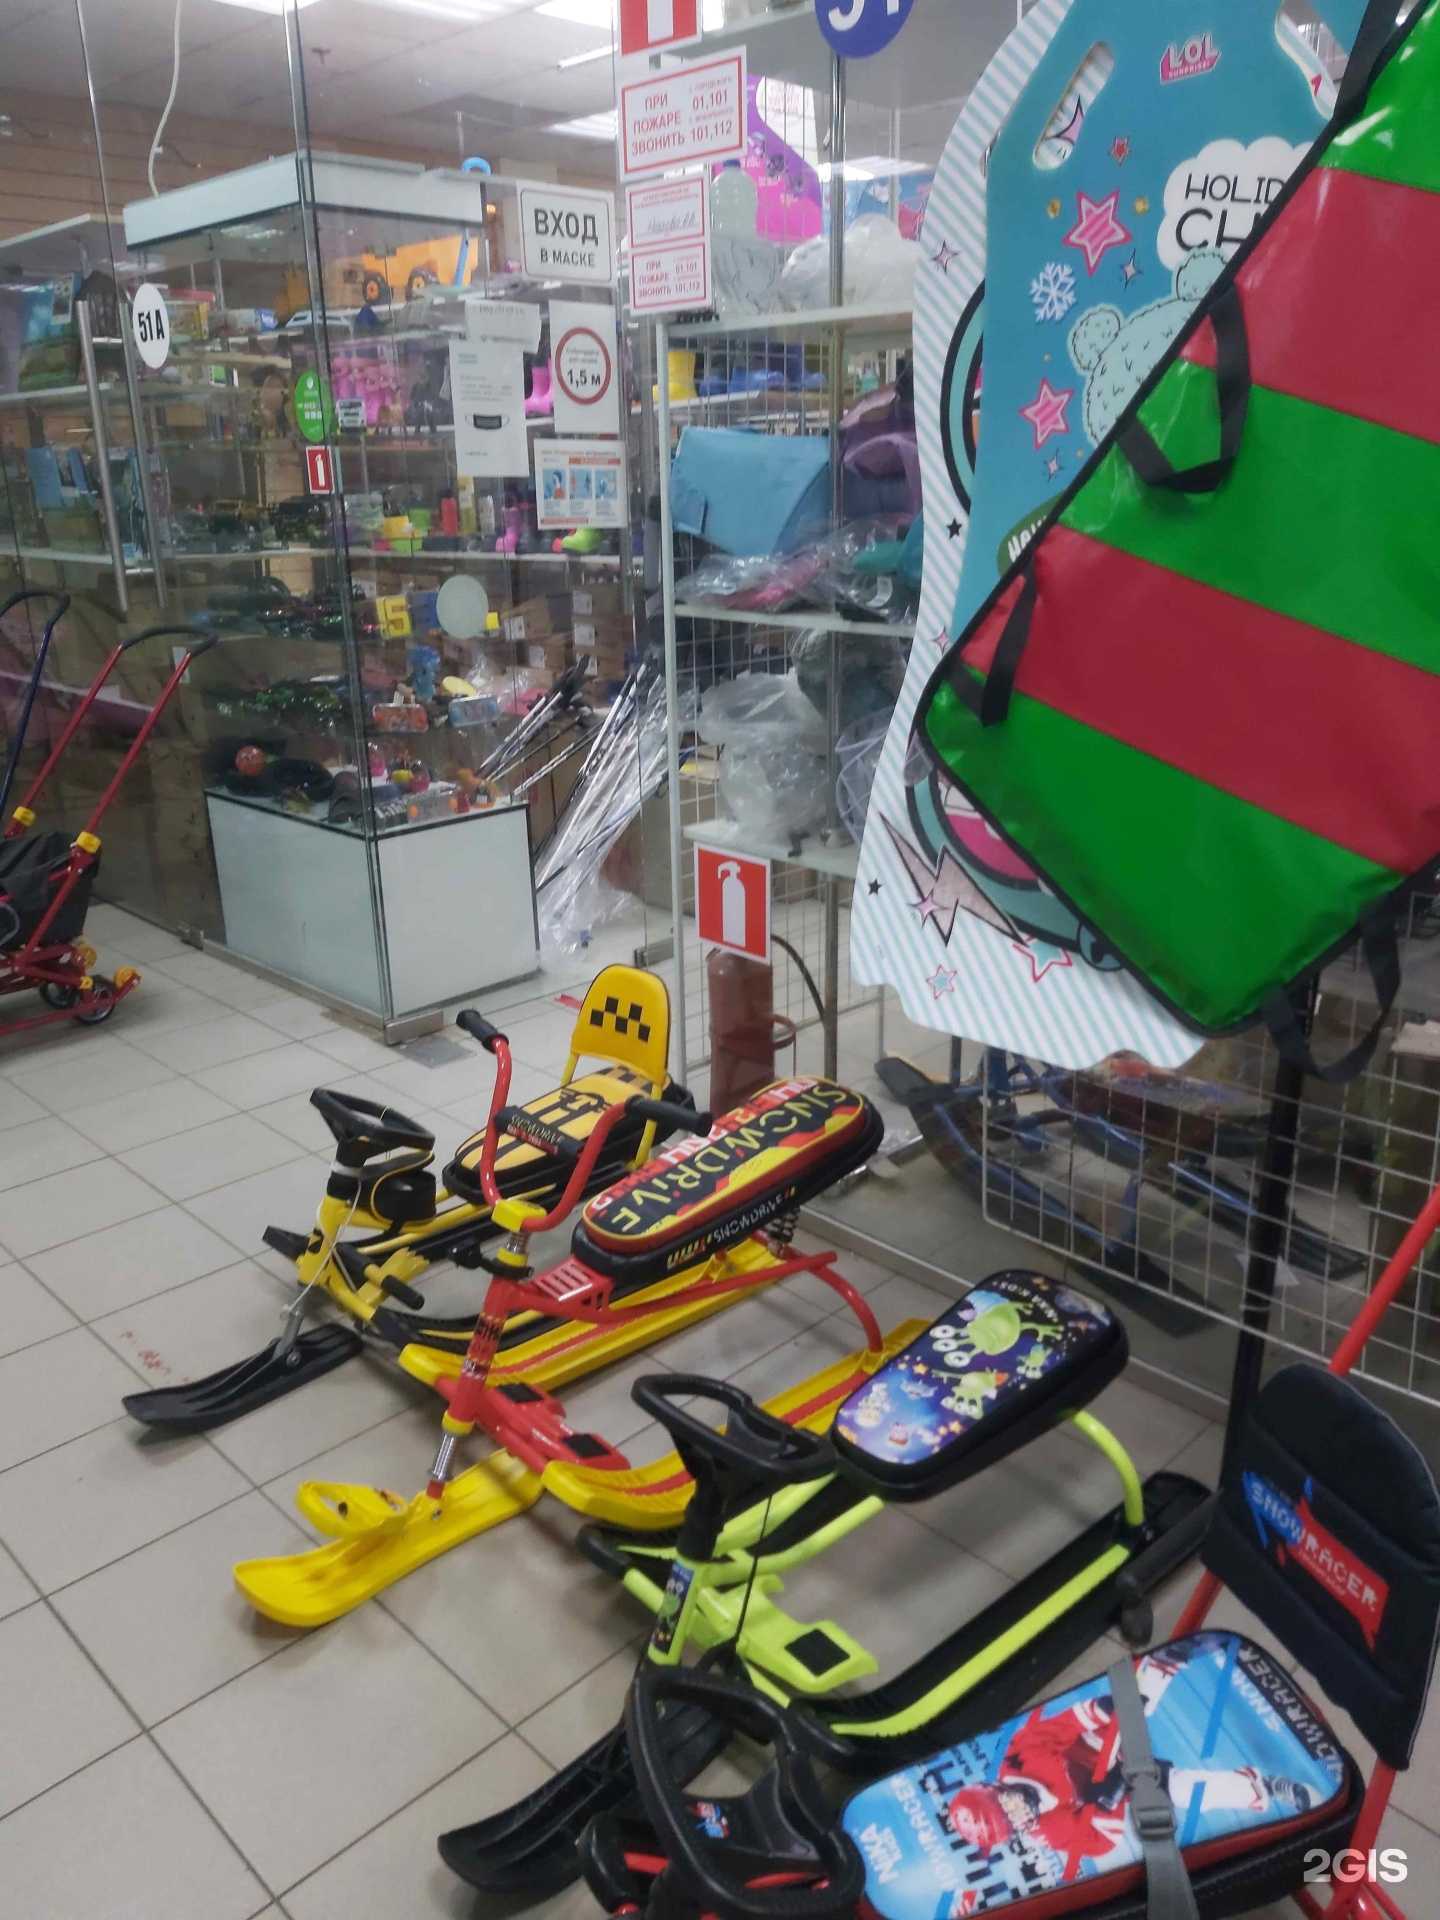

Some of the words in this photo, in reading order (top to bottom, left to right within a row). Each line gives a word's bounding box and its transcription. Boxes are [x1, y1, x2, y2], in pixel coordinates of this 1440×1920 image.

[645, 93, 668, 112] ПРИ
[692, 89, 728, 111] 01,101
[633, 111, 681, 135] ПОЖАРЕ
[690, 120, 733, 143] 101,112
[631, 132, 685, 157] ЗВОНИТЬ
[1185, 173, 1286, 204] HOLID
[534, 208, 599, 246] ВХОД
[540, 248, 549, 264] В
[552, 250, 595, 268] МАСКЕ
[567, 368, 587, 388] 1,5
